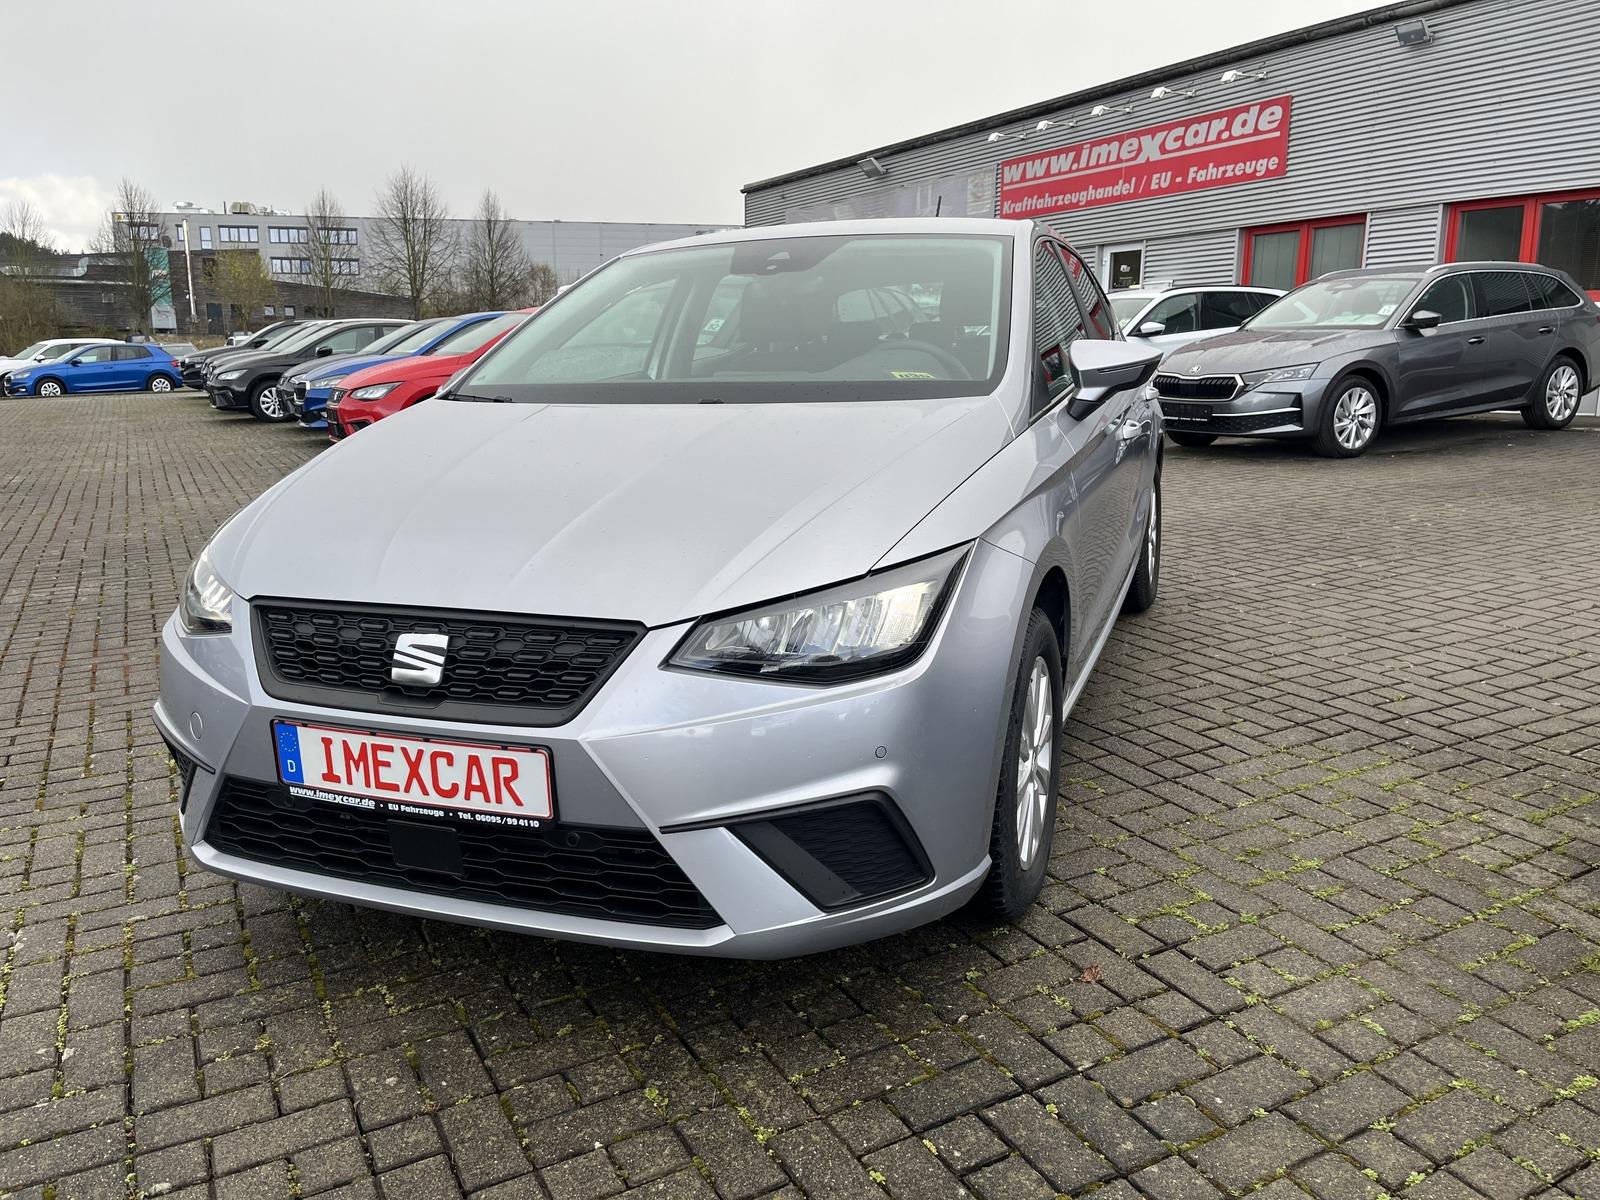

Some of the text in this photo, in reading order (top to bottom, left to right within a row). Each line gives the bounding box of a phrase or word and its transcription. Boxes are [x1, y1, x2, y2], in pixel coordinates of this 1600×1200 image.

[1003, 104, 1283, 184] www.imexcar.de
[1003, 177, 1135, 215] Kraftfahrzeughandel
[1150, 171, 1172, 191] EU
[1187, 154, 1279, 185] Fahrzeuge
[287, 759, 297, 773] D
[320, 736, 524, 807] IMEXCAR
[289, 786, 376, 808] www.imexcar.de
[388, 803, 399, 811] EU
[400, 804, 445, 817] Fahrzeuge
[457, 812, 474, 821] Tel.
